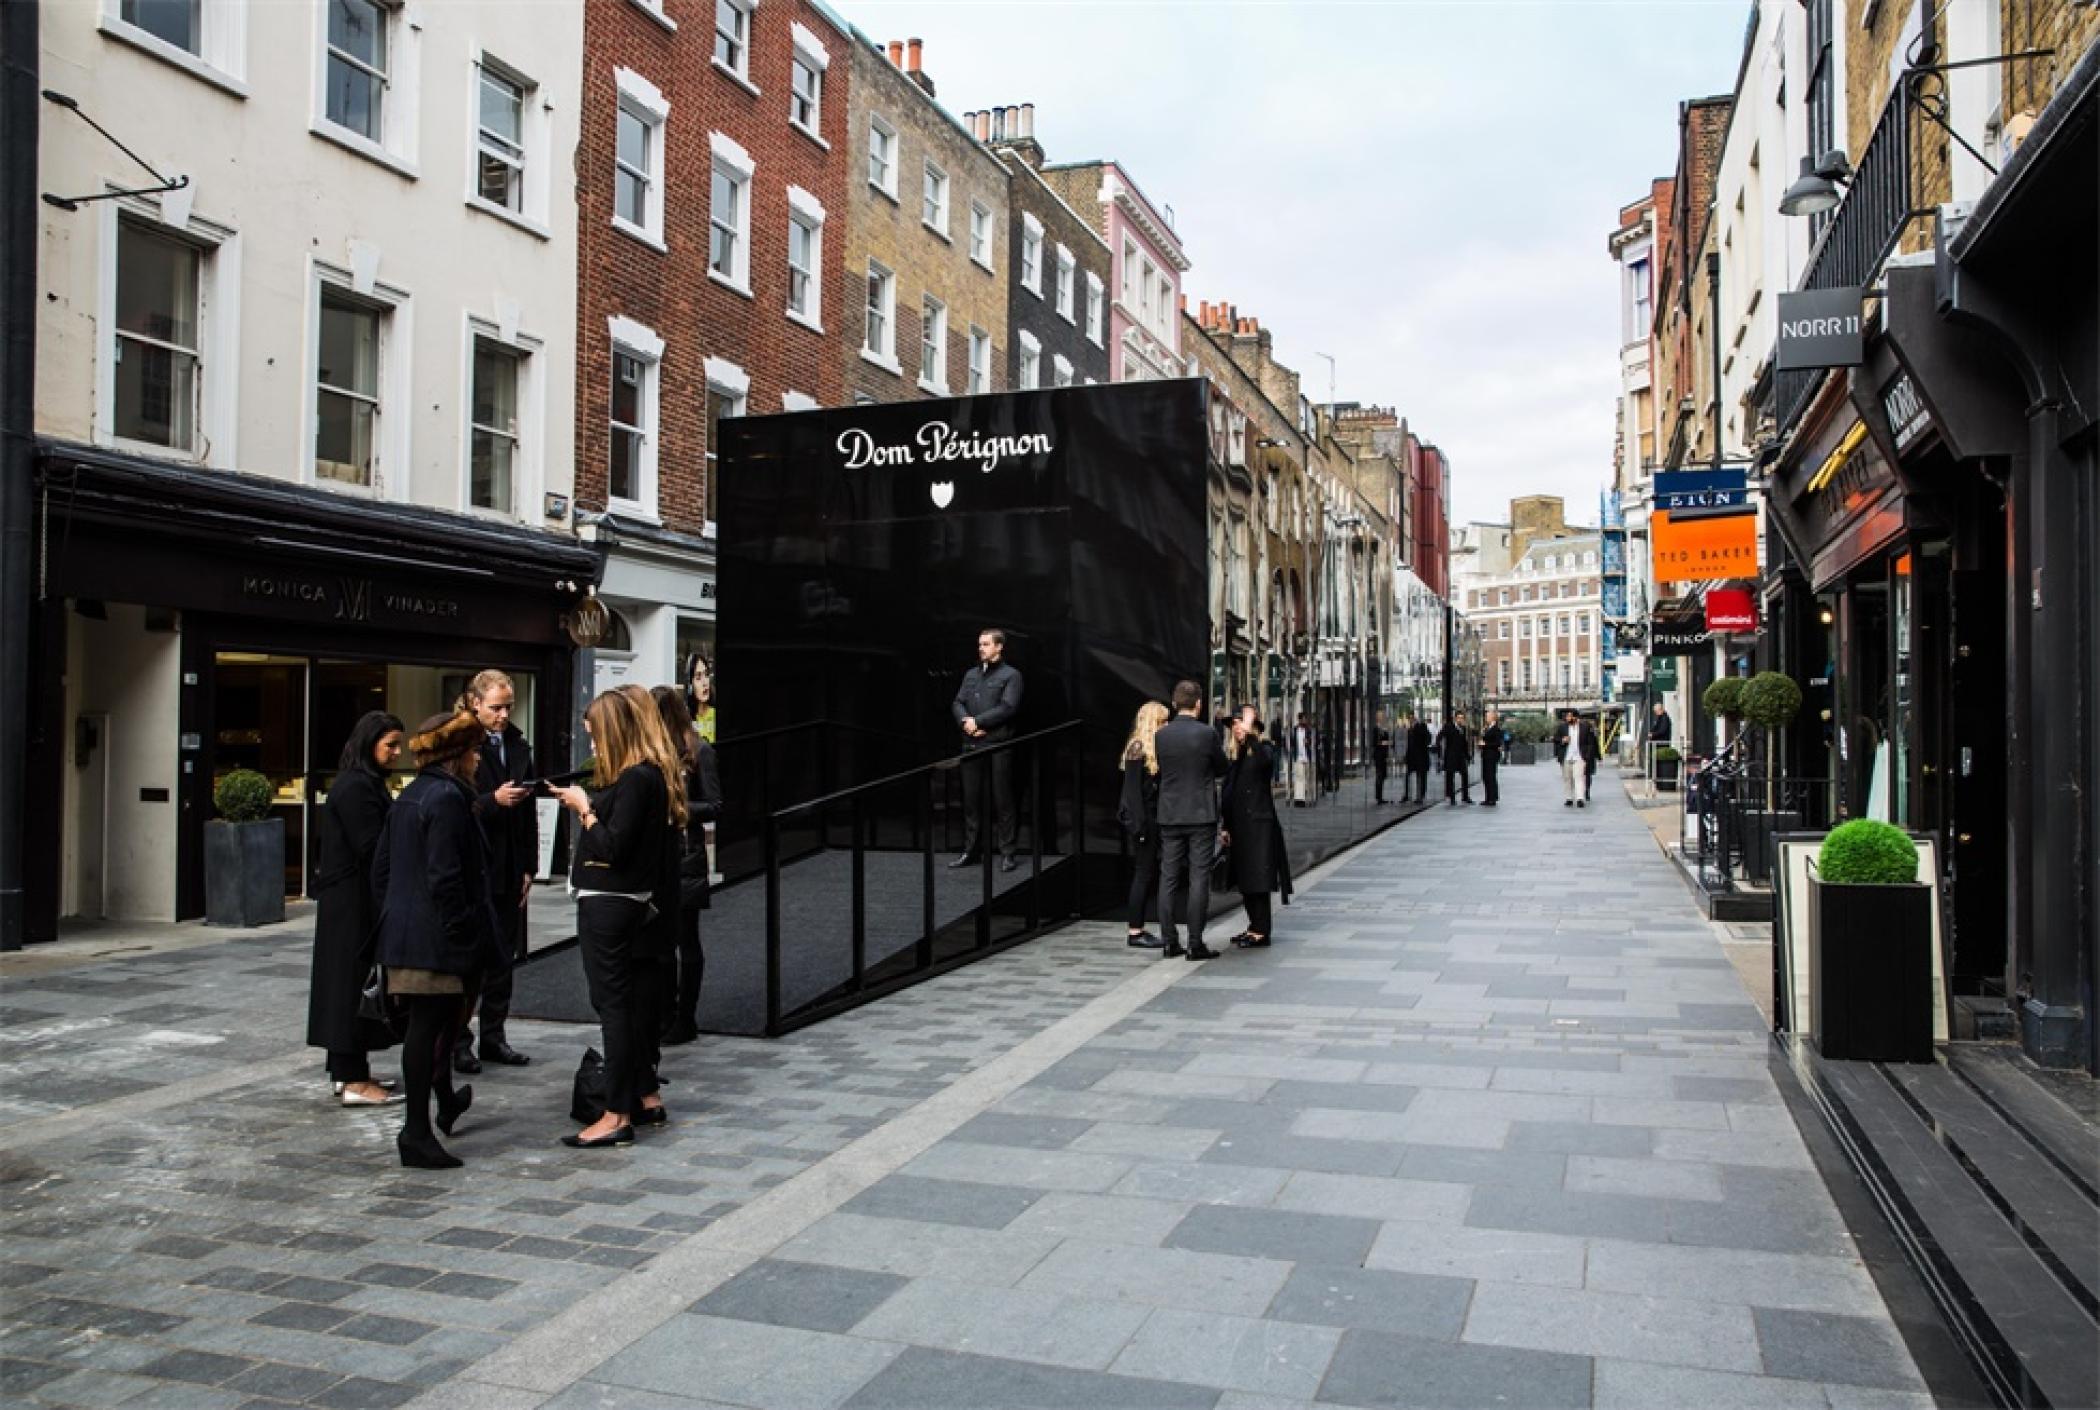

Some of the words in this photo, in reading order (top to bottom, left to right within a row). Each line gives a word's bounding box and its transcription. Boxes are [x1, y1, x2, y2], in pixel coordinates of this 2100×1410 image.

[836, 427, 915, 469] Dom
[916, 420, 1053, 473] Pérignon
[1660, 551, 1688, 562] TED
[1701, 547, 1752, 560] BAKER
[243, 576, 326, 601] MONICA
[384, 594, 459, 616] VINADER
